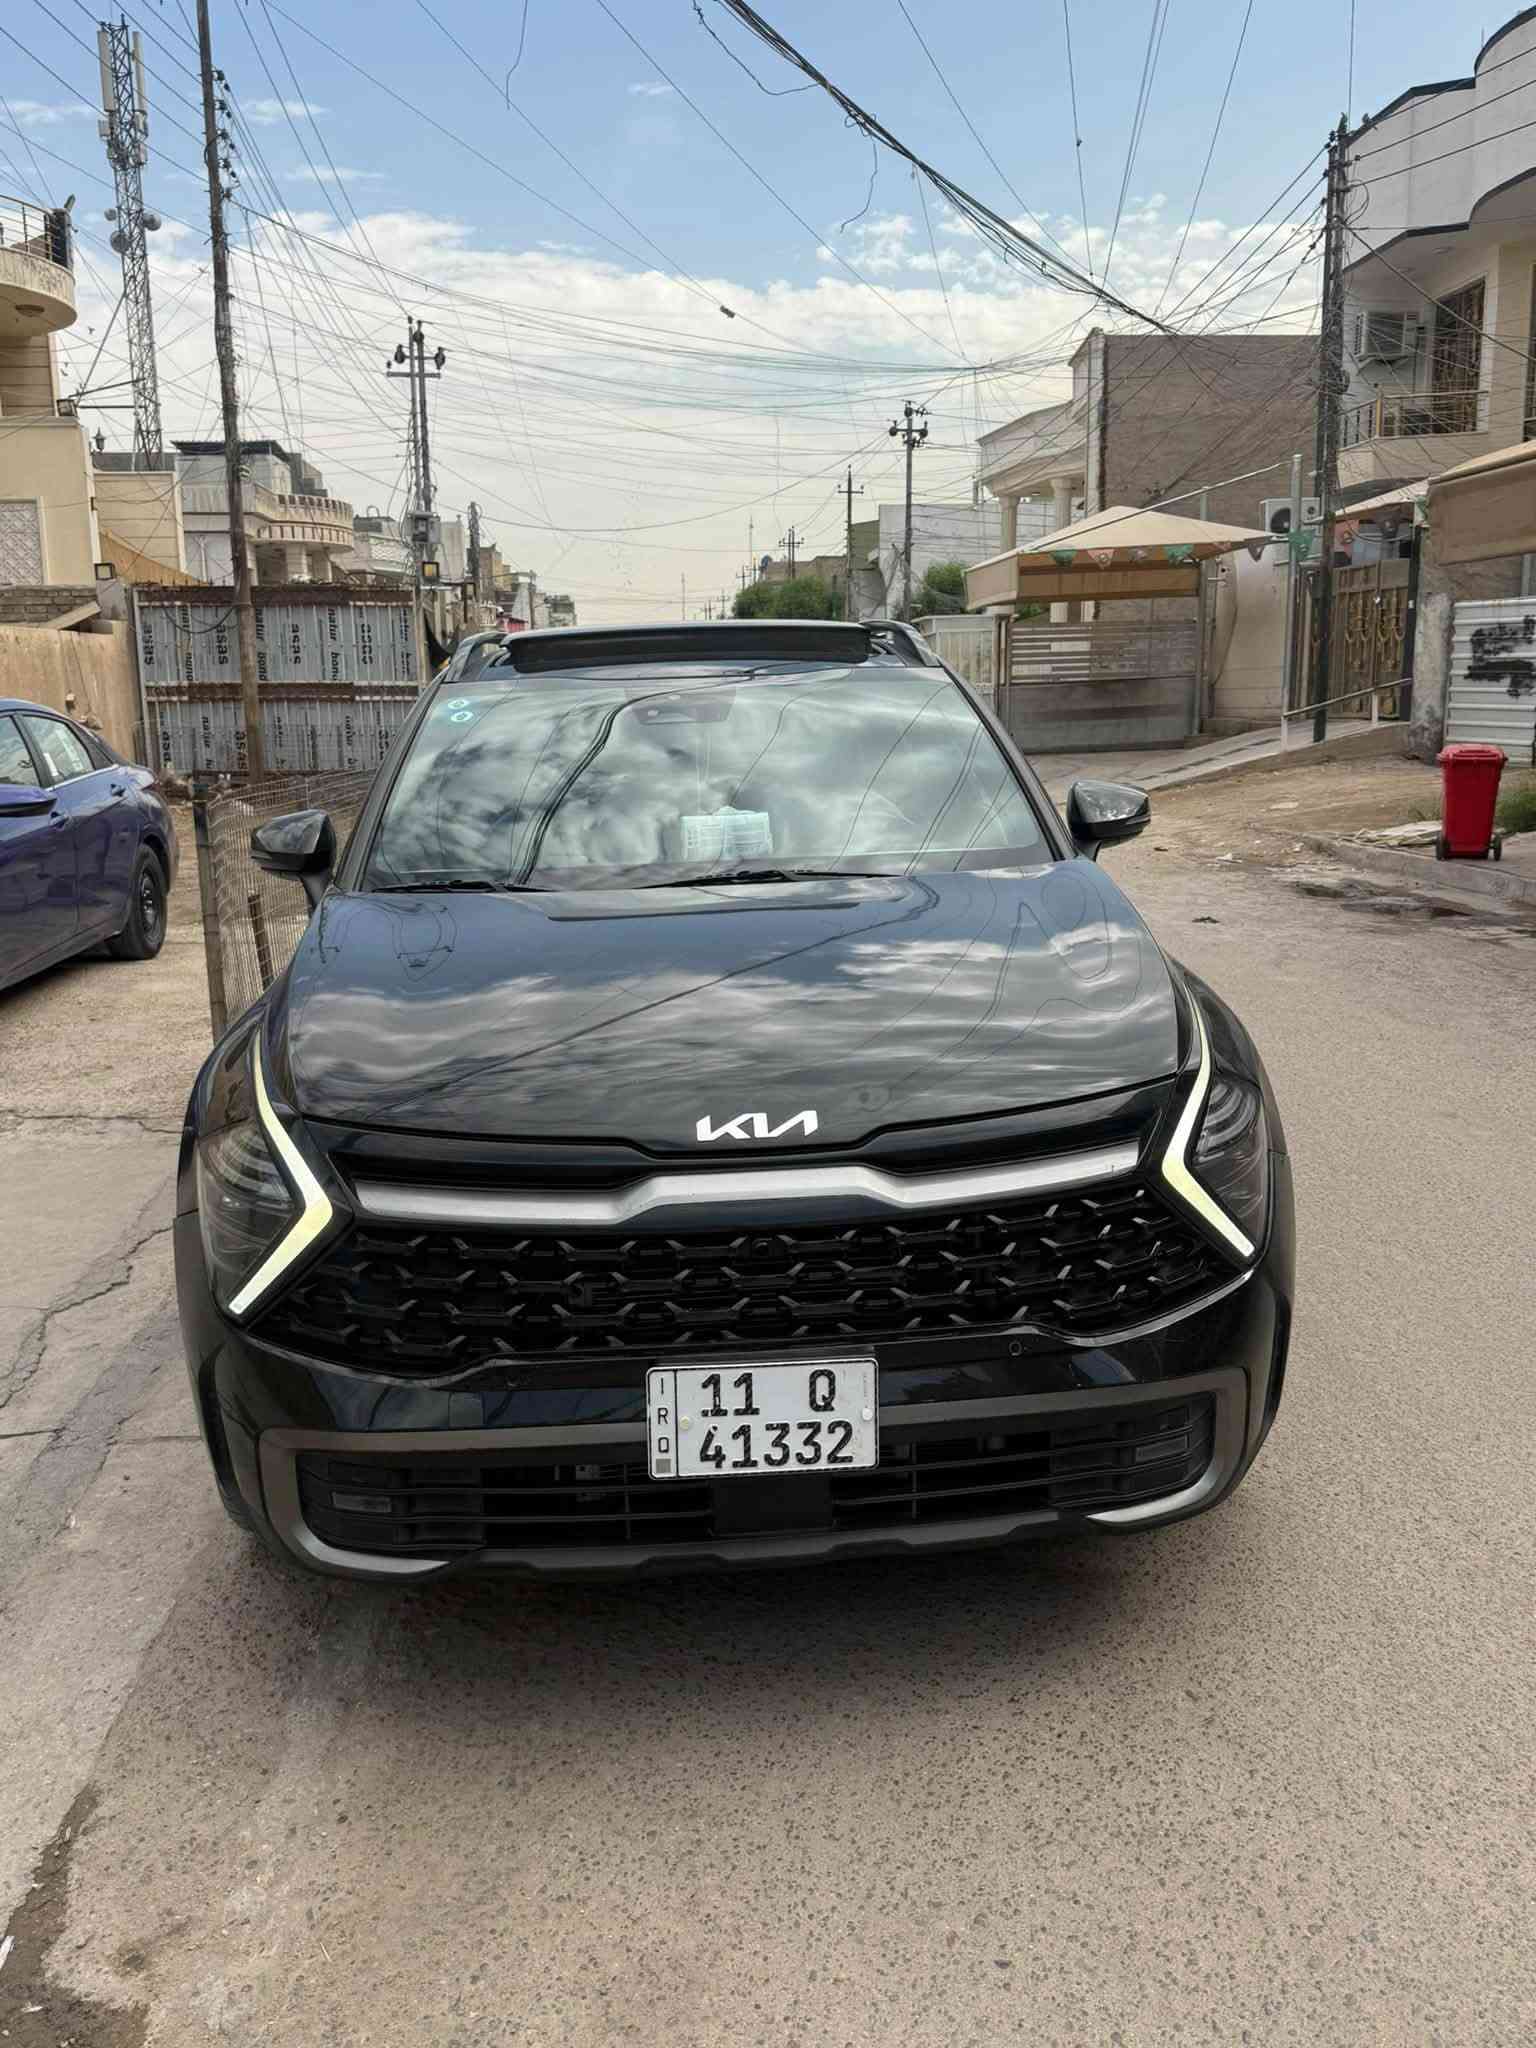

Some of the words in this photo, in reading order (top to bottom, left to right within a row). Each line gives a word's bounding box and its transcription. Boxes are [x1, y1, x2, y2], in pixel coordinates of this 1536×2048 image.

[216, 624, 229, 665] asas
[290, 624, 302, 665] asas
[327, 608, 338, 641] natur
[696, 1110, 818, 1141] KIA
[701, 1372, 760, 1417] 11
[809, 1369, 836, 1412] Q
[700, 1420, 853, 1469] 41332
